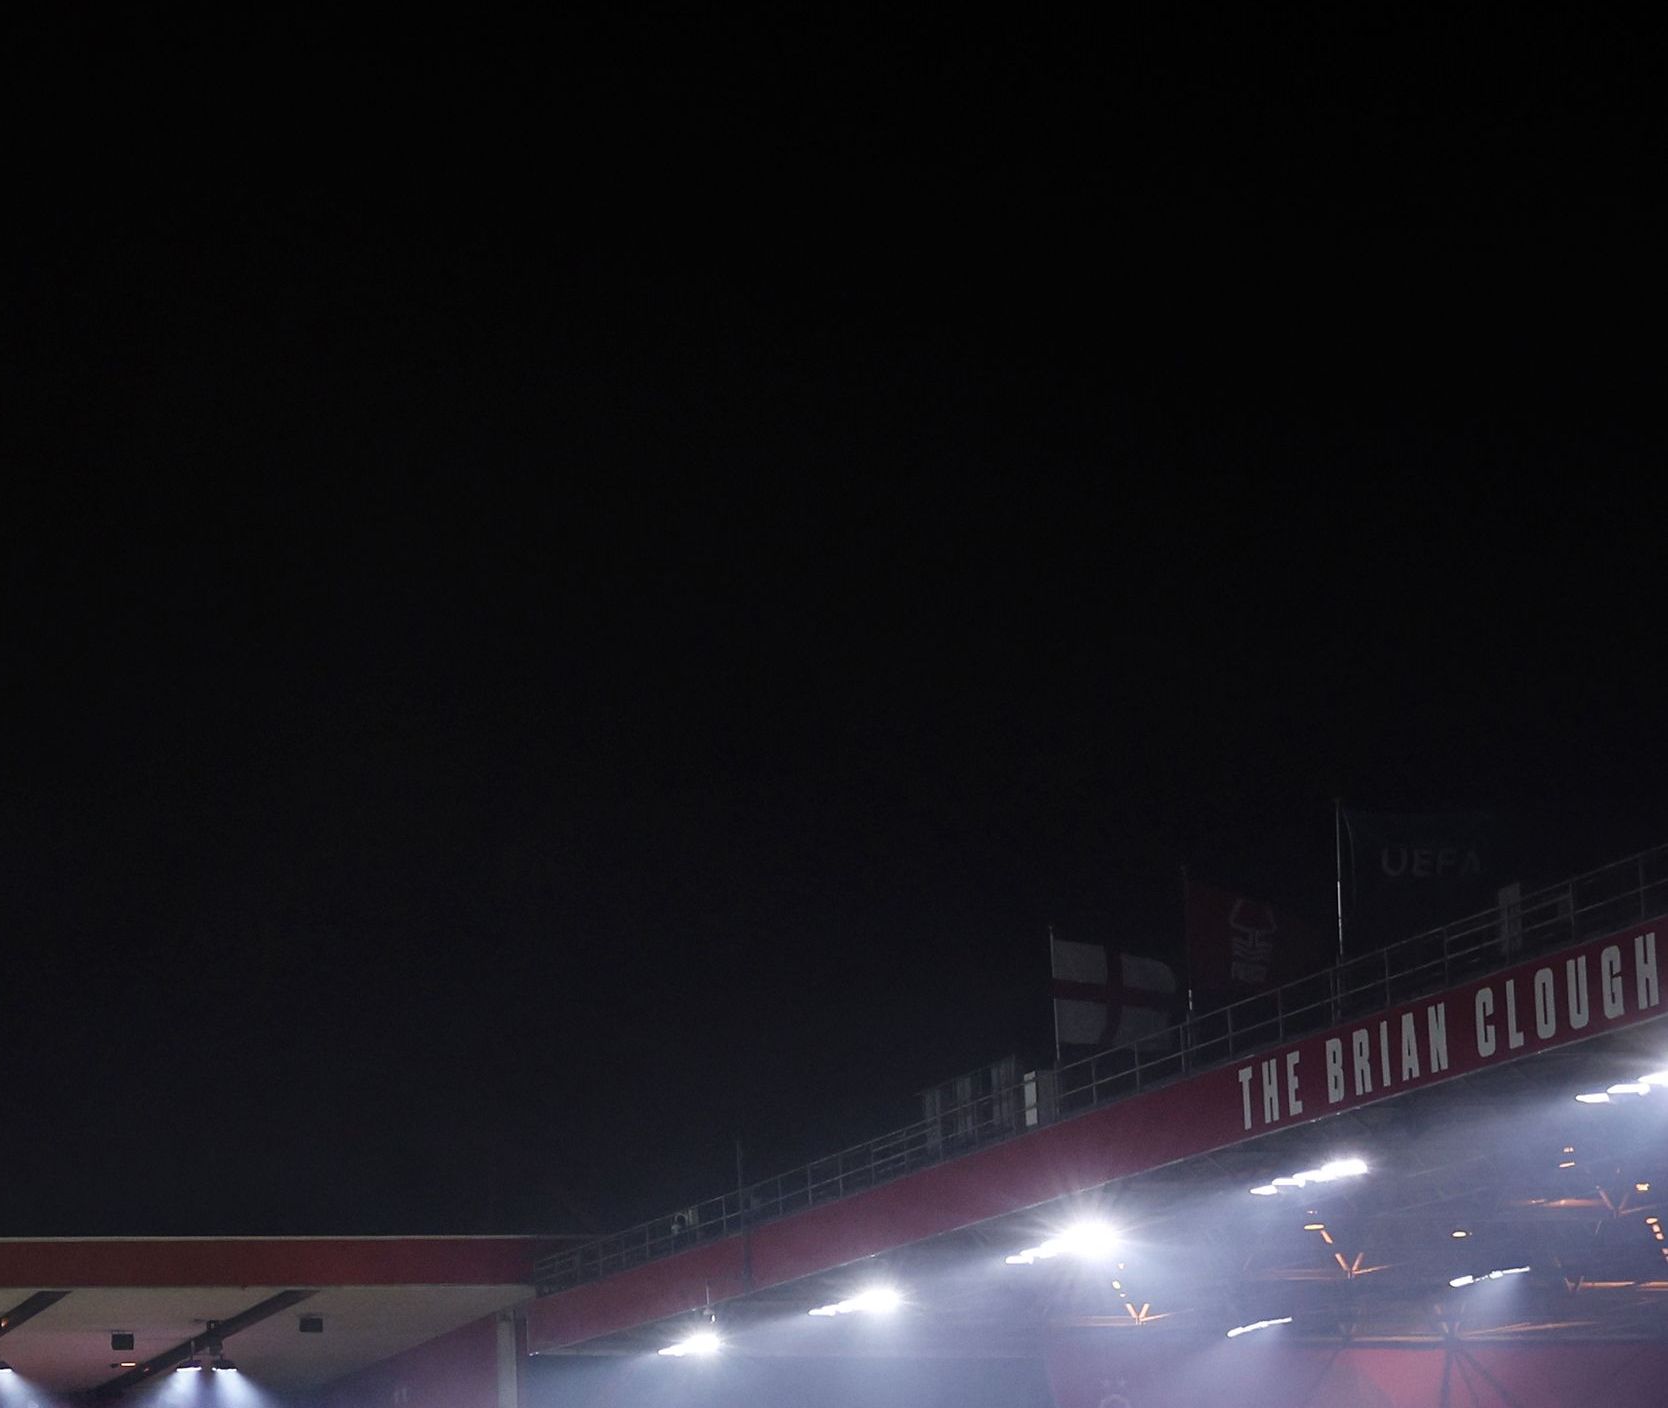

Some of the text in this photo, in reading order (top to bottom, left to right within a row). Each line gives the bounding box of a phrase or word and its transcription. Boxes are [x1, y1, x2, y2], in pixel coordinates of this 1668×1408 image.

[1239, 932, 1660, 1130] THE BRIAN CLOUGH
